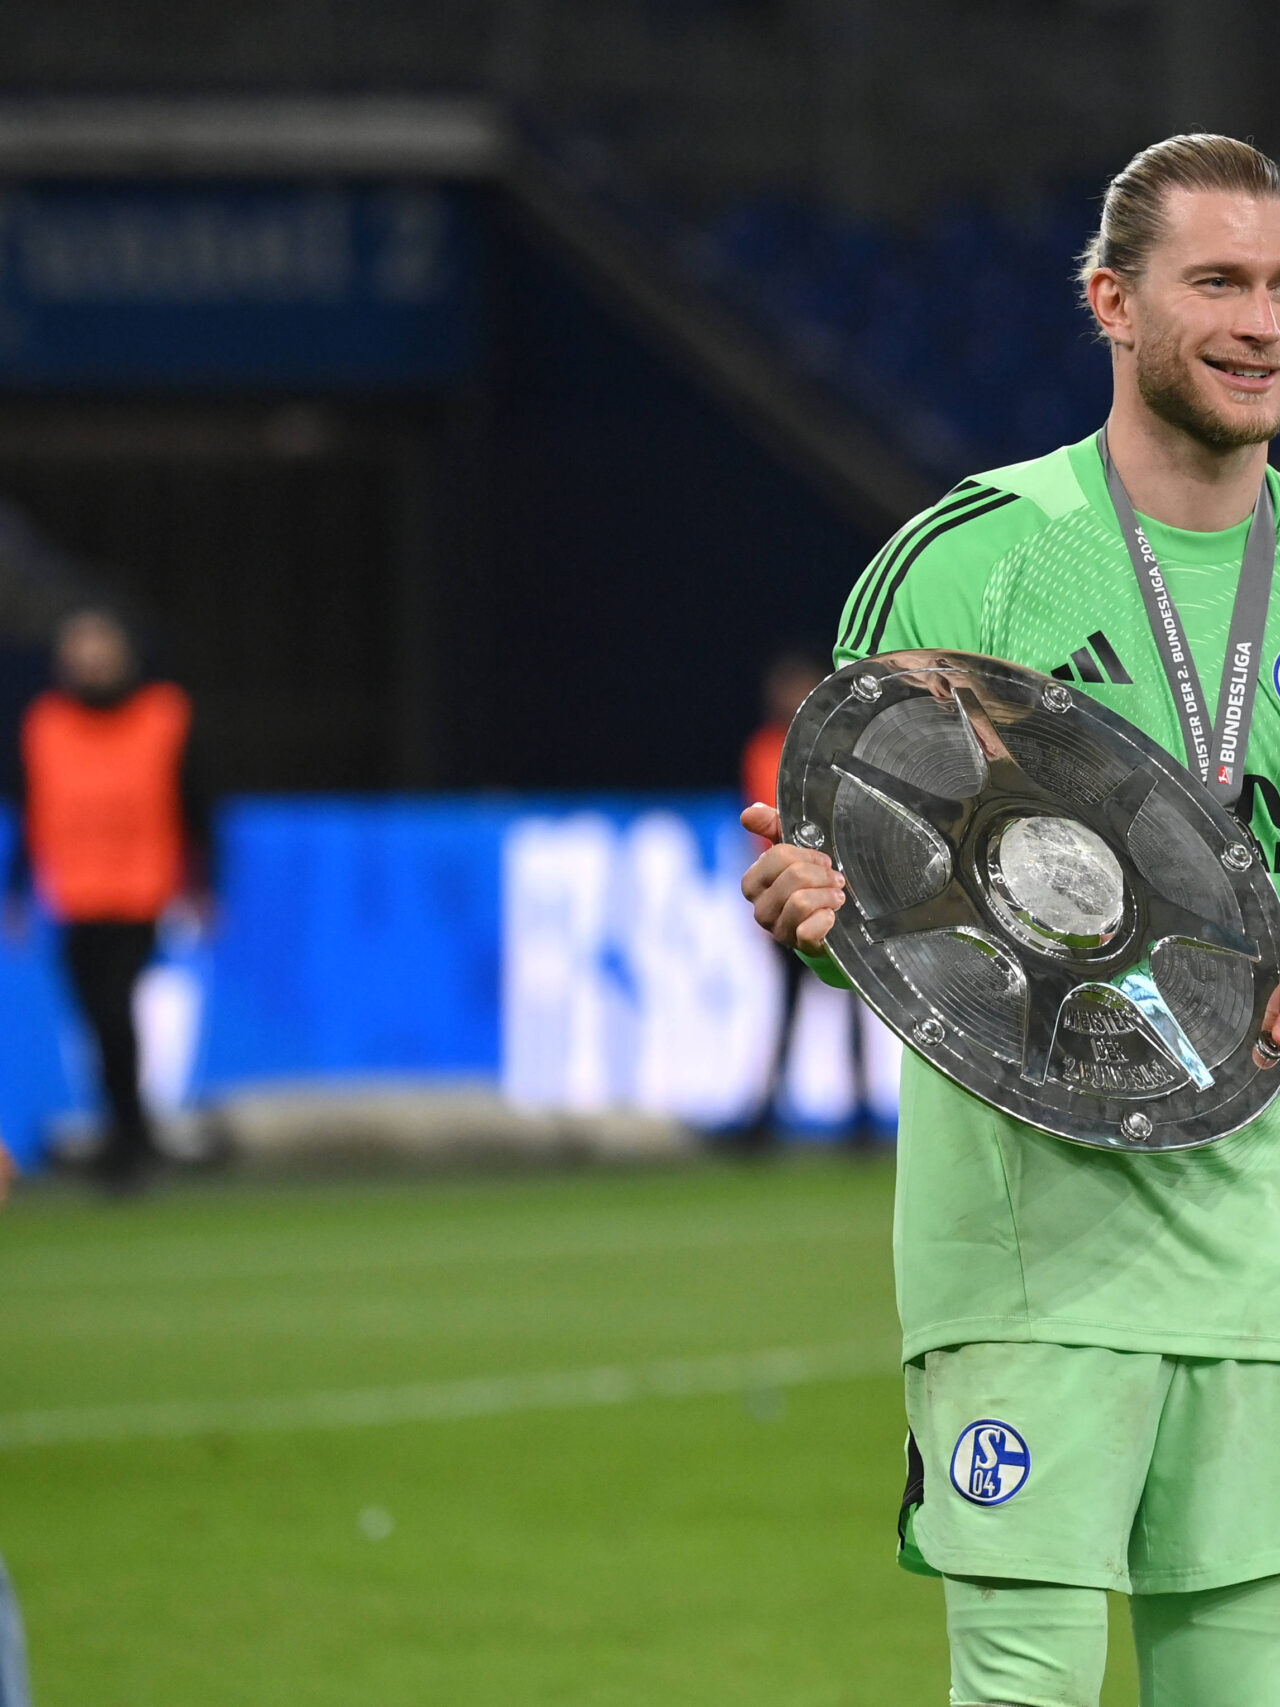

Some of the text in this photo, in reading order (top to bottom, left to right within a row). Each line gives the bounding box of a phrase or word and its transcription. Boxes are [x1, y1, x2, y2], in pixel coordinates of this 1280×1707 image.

[1149, 566, 1184, 663] BUNDESLIGA
[1177, 665, 1189, 679] 2.
[1181, 682, 1197, 713] DER
[1219, 642, 1252, 763] BUNDESLIGA
[1189, 716, 1210, 783] MEISTER
[973, 1470, 995, 1496] 04
